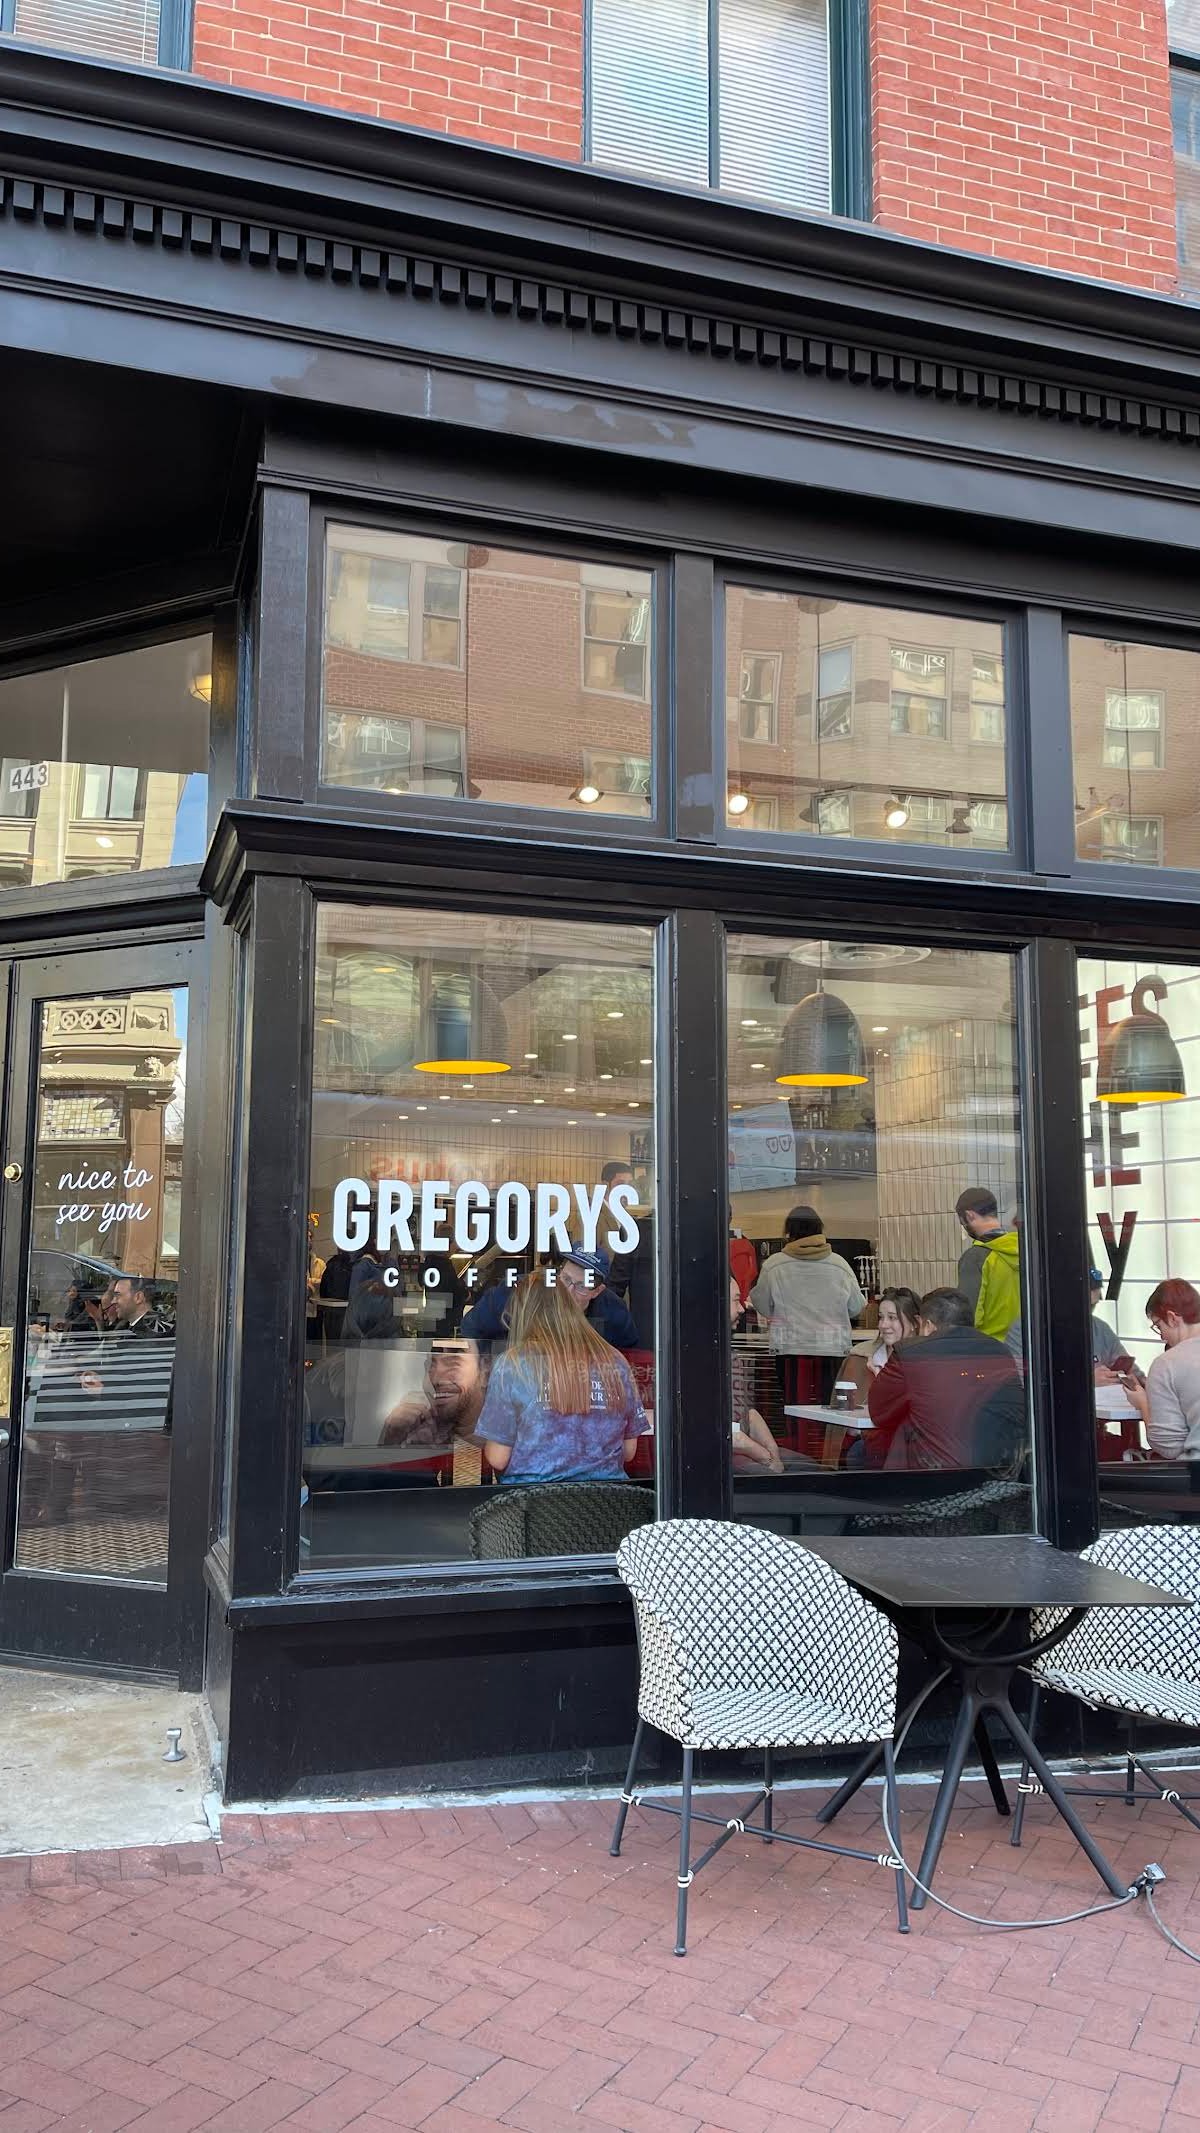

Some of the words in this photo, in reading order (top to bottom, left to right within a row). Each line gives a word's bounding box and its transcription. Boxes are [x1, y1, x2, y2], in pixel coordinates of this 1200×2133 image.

[11, 764, 48, 790] 443
[58, 1161, 118, 1191] nice
[123, 1160, 154, 1189] to
[55, 1202, 96, 1225] see
[98, 1203, 152, 1233] you
[333, 1177, 641, 1255] GREGORYS
[383, 1267, 596, 1289] COFFEE
